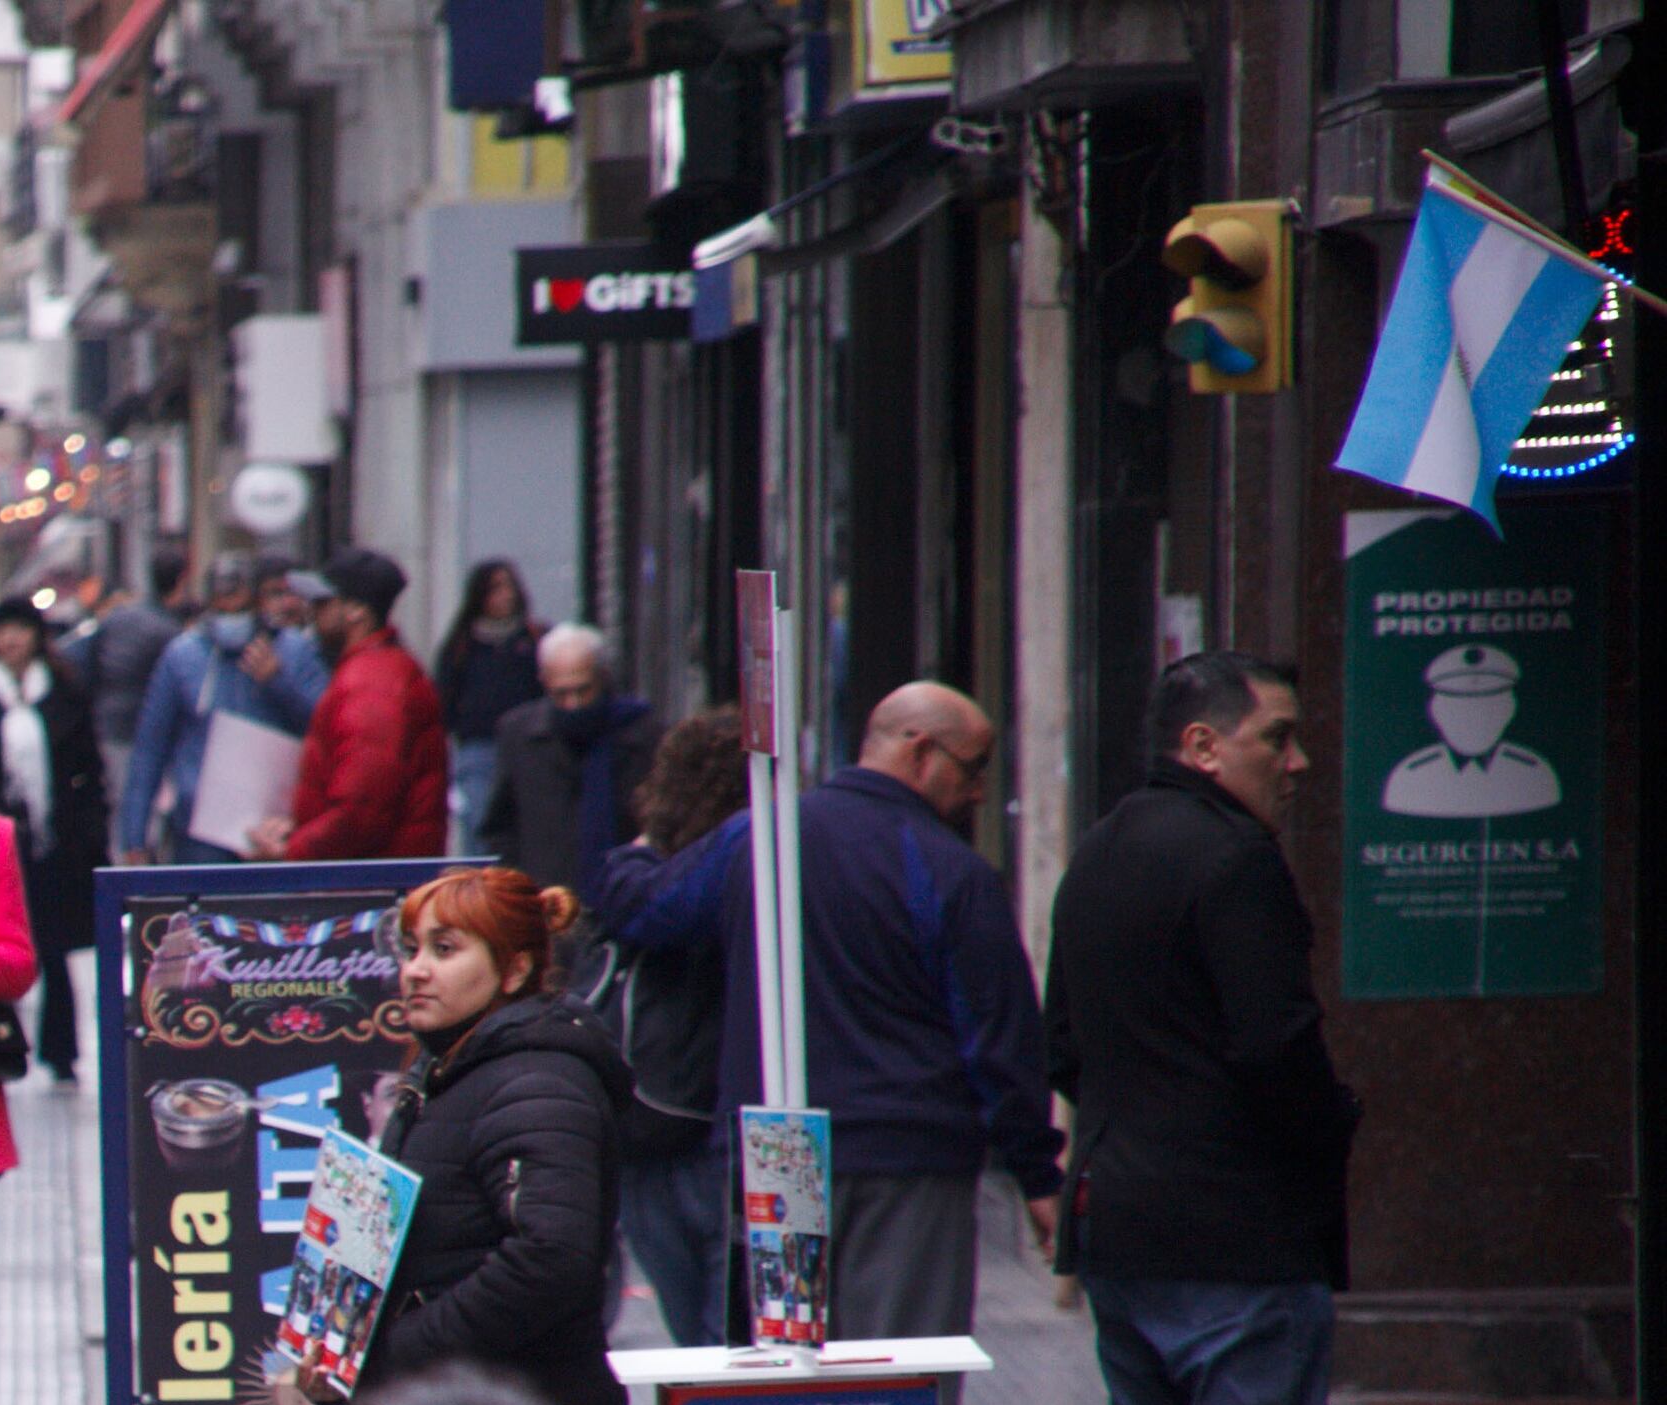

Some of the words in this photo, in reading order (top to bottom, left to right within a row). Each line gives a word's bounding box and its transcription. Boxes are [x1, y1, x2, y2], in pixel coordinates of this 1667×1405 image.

[533, 277, 549, 314] I
[1374, 589, 1574, 613] PROPIEDAD
[1374, 612, 1573, 637] PROTEGIDA
[1361, 840, 1527, 867] SEGURCIEN
[230, 980, 349, 999] REGIONALES
